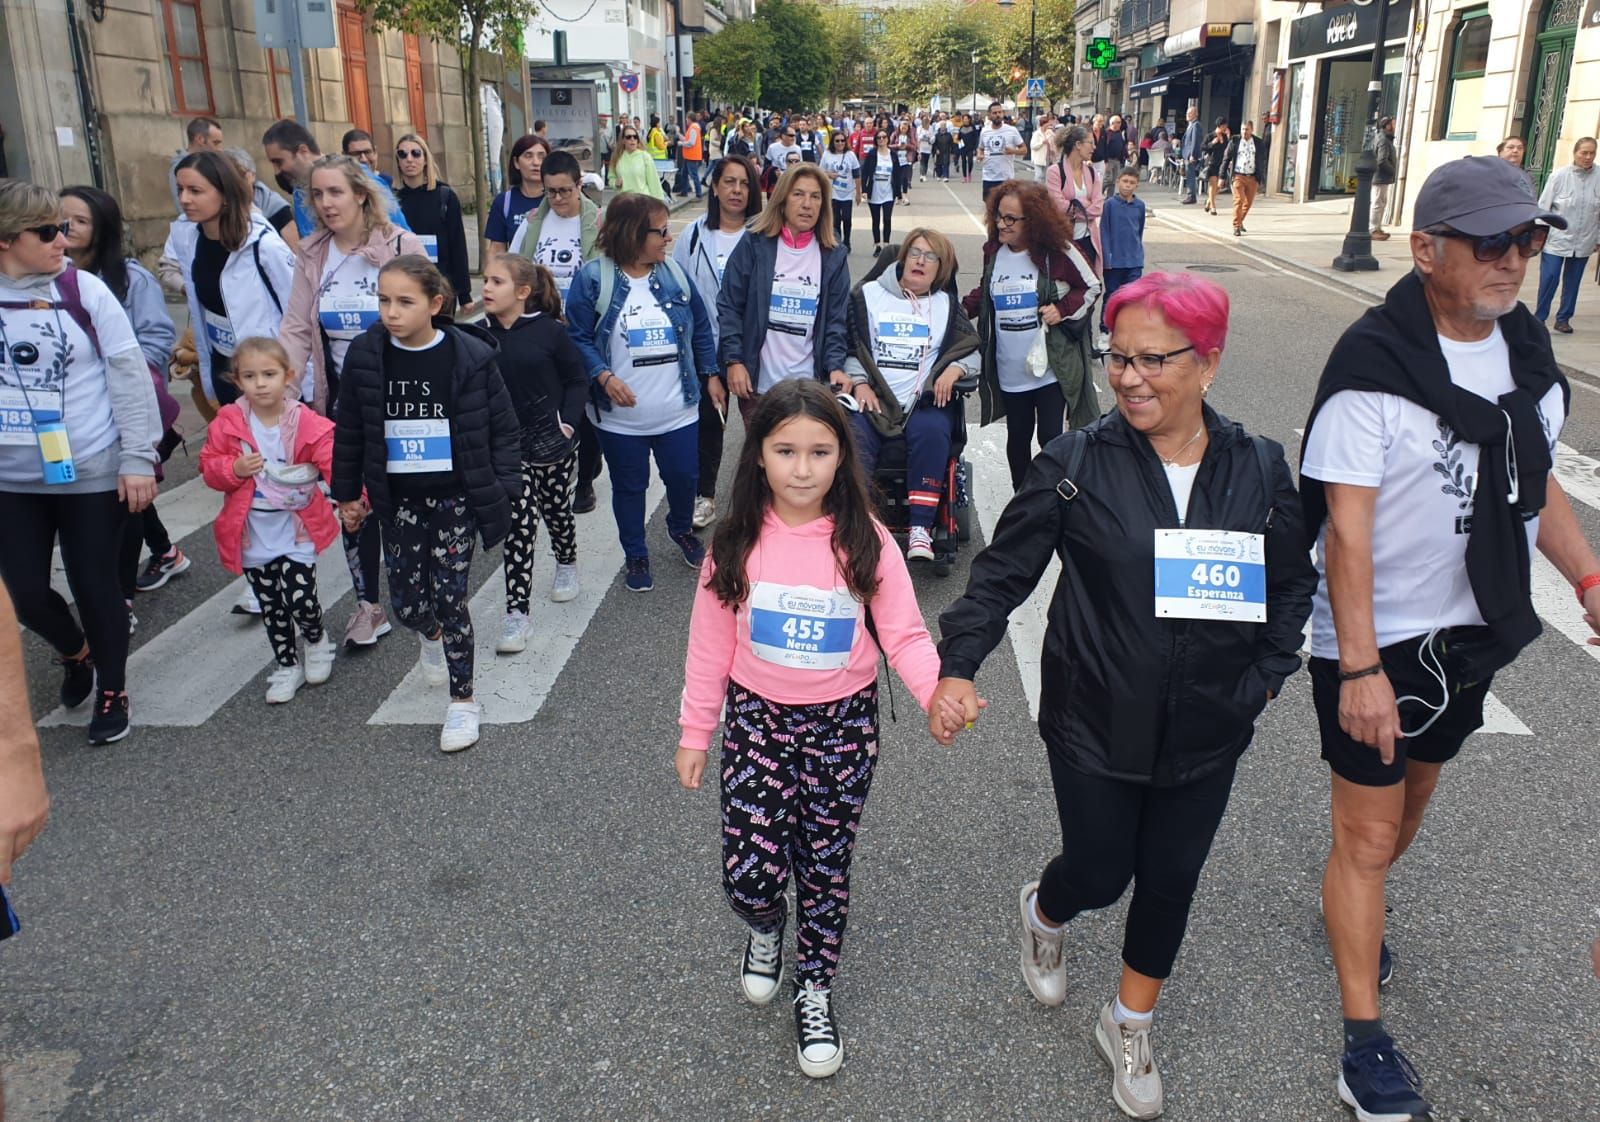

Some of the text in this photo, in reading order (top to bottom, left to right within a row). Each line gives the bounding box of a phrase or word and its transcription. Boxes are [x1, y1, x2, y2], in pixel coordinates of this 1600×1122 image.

[1210, 26, 1228, 34] BAR
[781, 298, 801, 309] 333
[1006, 295, 1022, 305] 557
[338, 312, 361, 325] 198
[645, 329, 666, 341] 355
[894, 324, 914, 333] 334
[216, 329, 233, 344] 360
[388, 380, 431, 396] IT'S
[386, 403, 446, 418] UPER
[0, 411, 32, 425] 189
[400, 439, 425, 453] 191
[1191, 563, 1241, 588] 460
[1187, 586, 1245, 601] Esperanza
[782, 617, 825, 641] 455
[786, 638, 818, 652] Nerea
